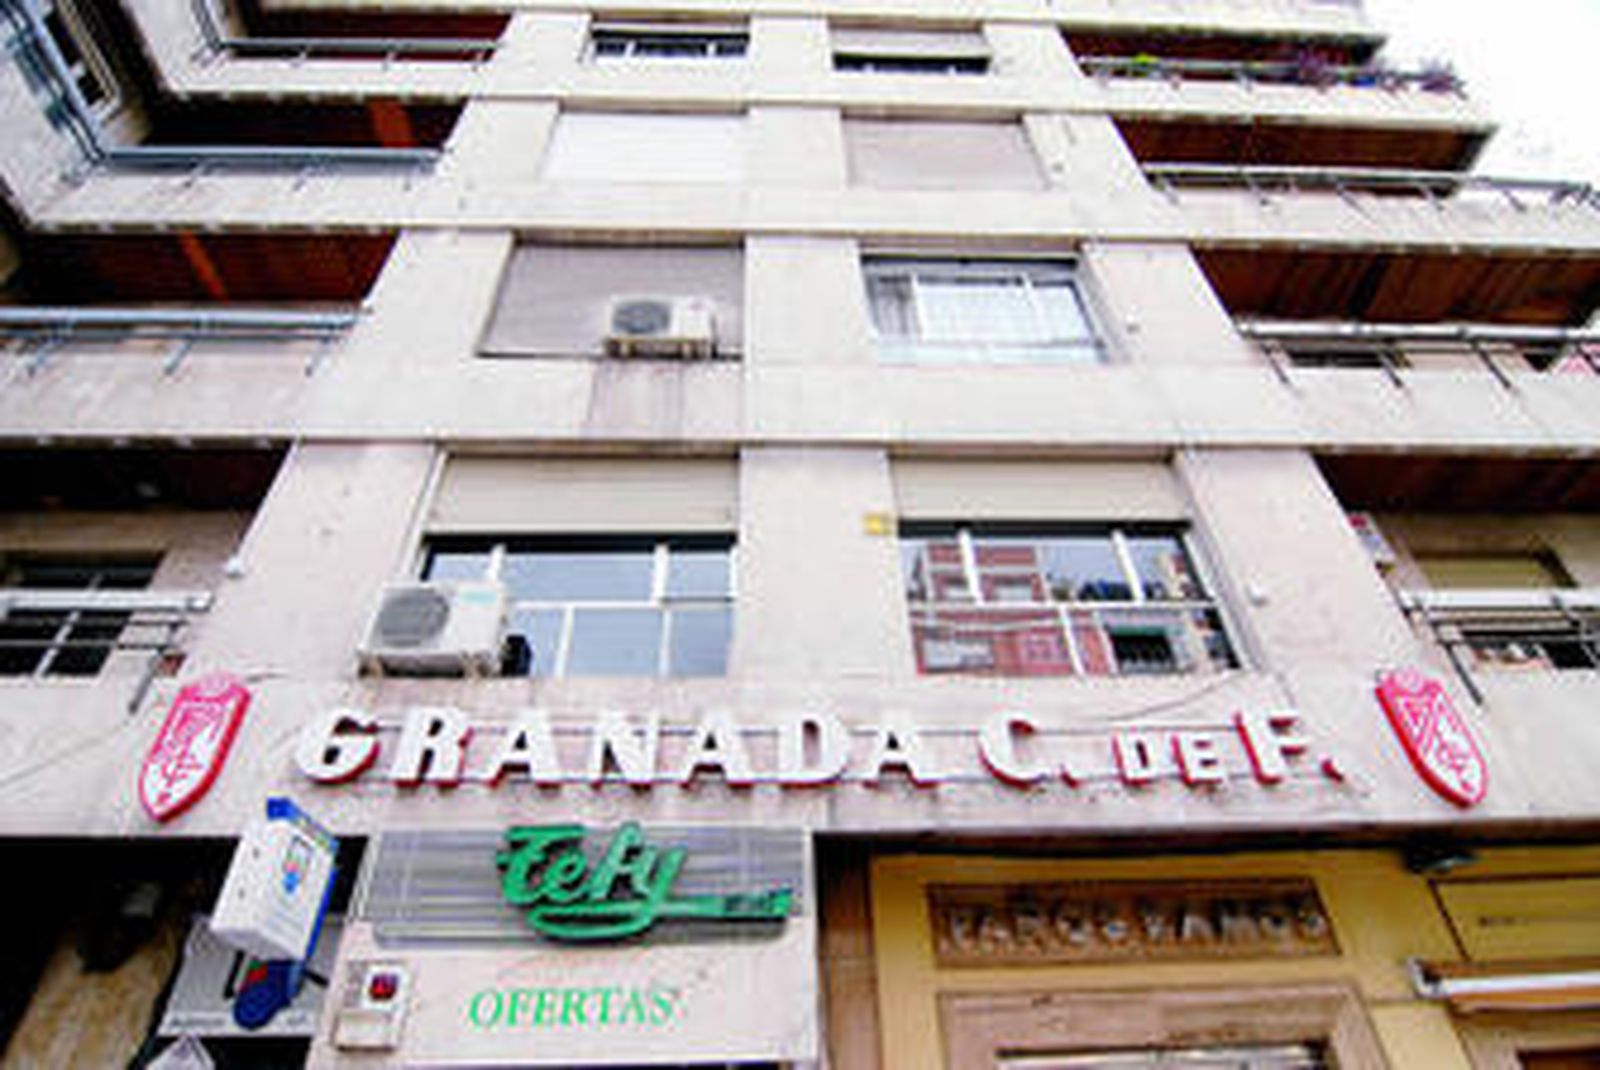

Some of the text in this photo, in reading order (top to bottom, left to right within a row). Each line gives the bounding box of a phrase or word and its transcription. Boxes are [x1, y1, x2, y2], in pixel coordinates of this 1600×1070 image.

[296, 704, 1343, 789] GRANADA C. DE F.
[468, 985, 678, 1028] OFERTAS
